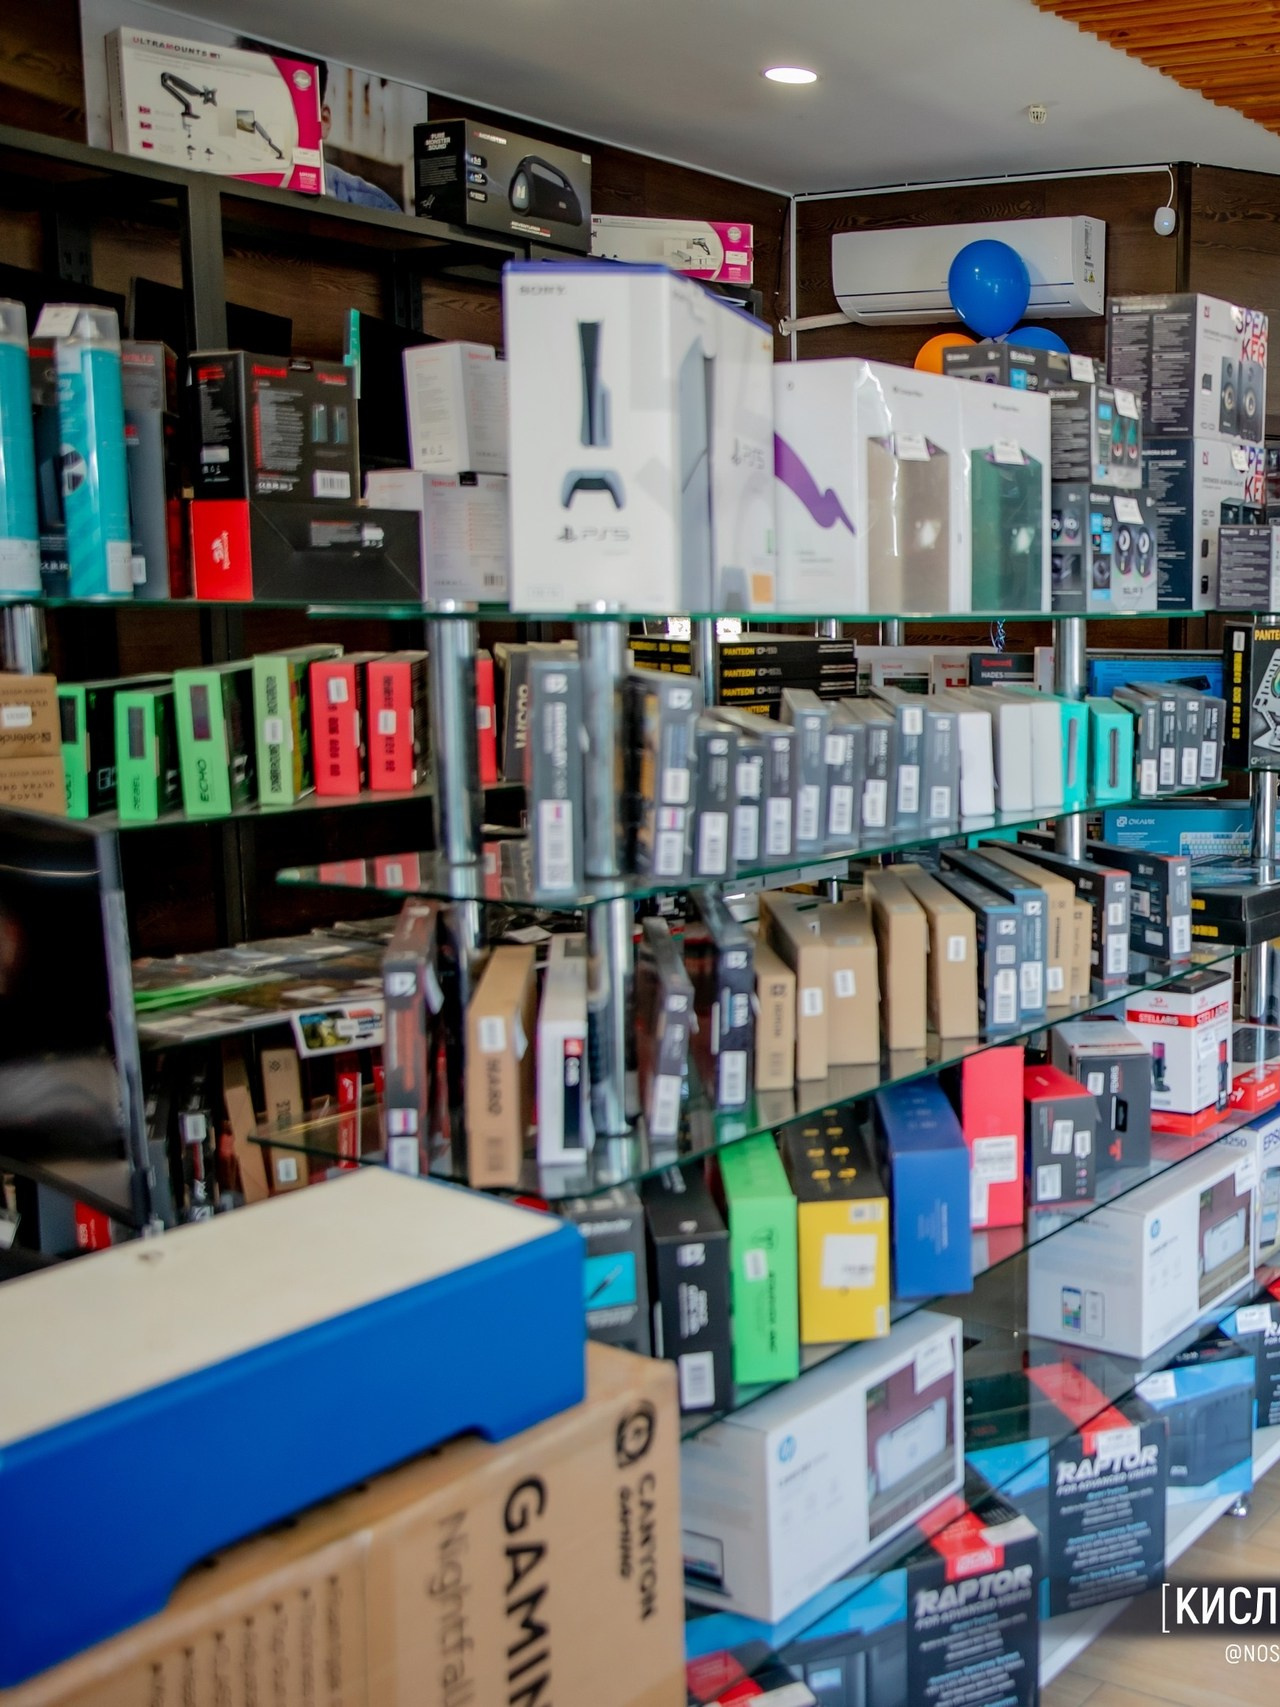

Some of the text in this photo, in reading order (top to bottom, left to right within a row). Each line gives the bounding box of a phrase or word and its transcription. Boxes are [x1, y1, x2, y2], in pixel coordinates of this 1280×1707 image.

[132, 36, 208, 57] ULTRAMOUNTS
[519, 285, 567, 296] SONY
[1241, 338, 1267, 369] KER
[723, 647, 755, 656] PANTEON
[723, 669, 756, 677] PANTEON
[722, 687, 755, 696] PANTEON
[197, 758, 210, 802] ECHO
[1138, 1013, 1179, 1026] STELLARIS
[1056, 1444, 1159, 1485] RAPTOR
[1056, 1484, 1078, 1497] FOR
[1078, 1473, 1127, 1493] ADVANCED
[620, 1486, 633, 1580] GAMING
[639, 1473, 658, 1622] CANYON
[915, 1564, 1034, 1619] RAPTOR
